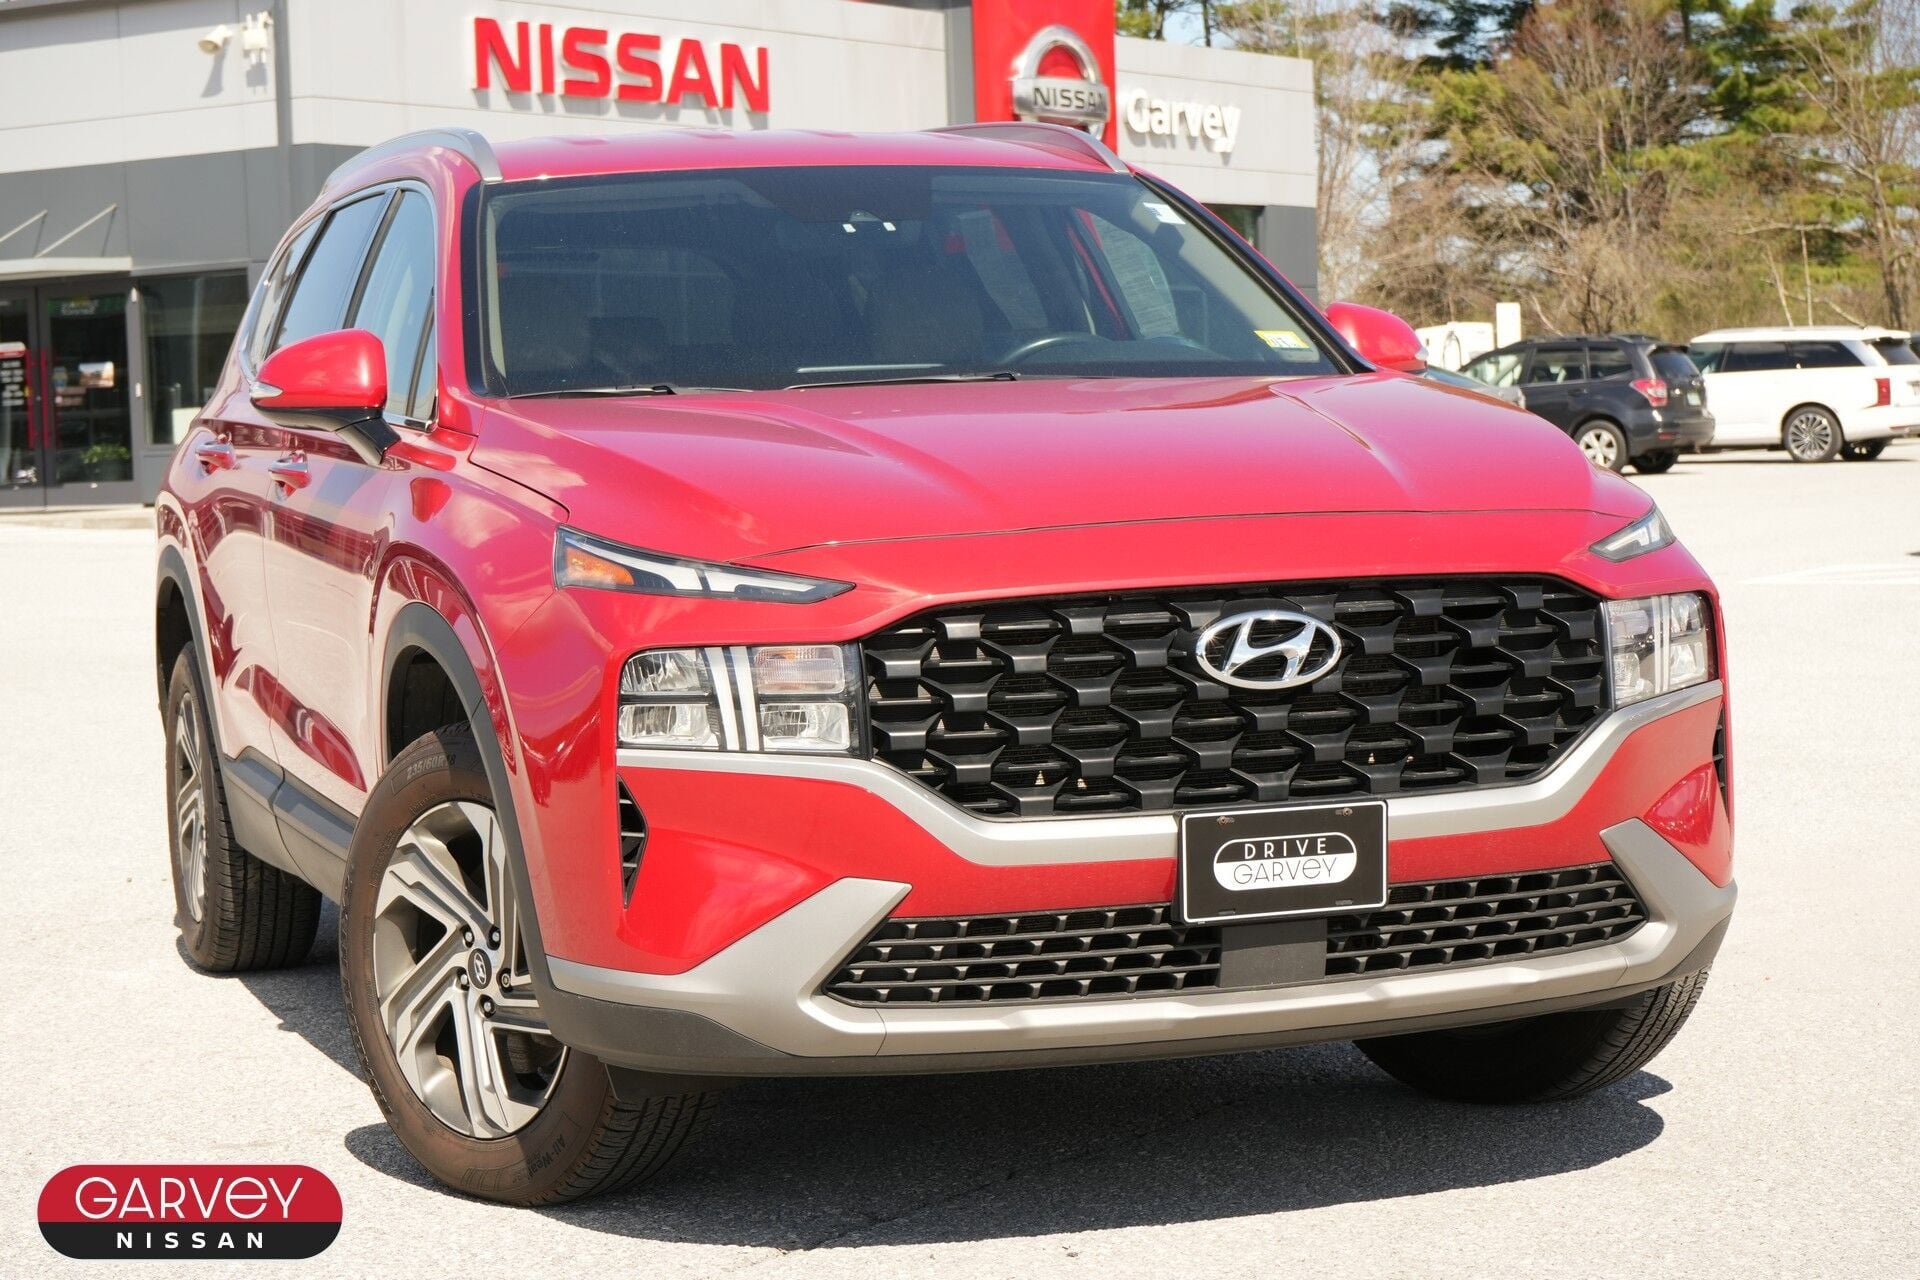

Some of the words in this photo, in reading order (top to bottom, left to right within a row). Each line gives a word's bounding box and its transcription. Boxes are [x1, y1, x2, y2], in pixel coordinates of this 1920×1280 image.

[474, 17, 769, 113] NISSAN
[1033, 87, 1106, 110] NISSAN
[1126, 88, 1241, 153] Garvey
[1244, 837, 1327, 860] DRIVE
